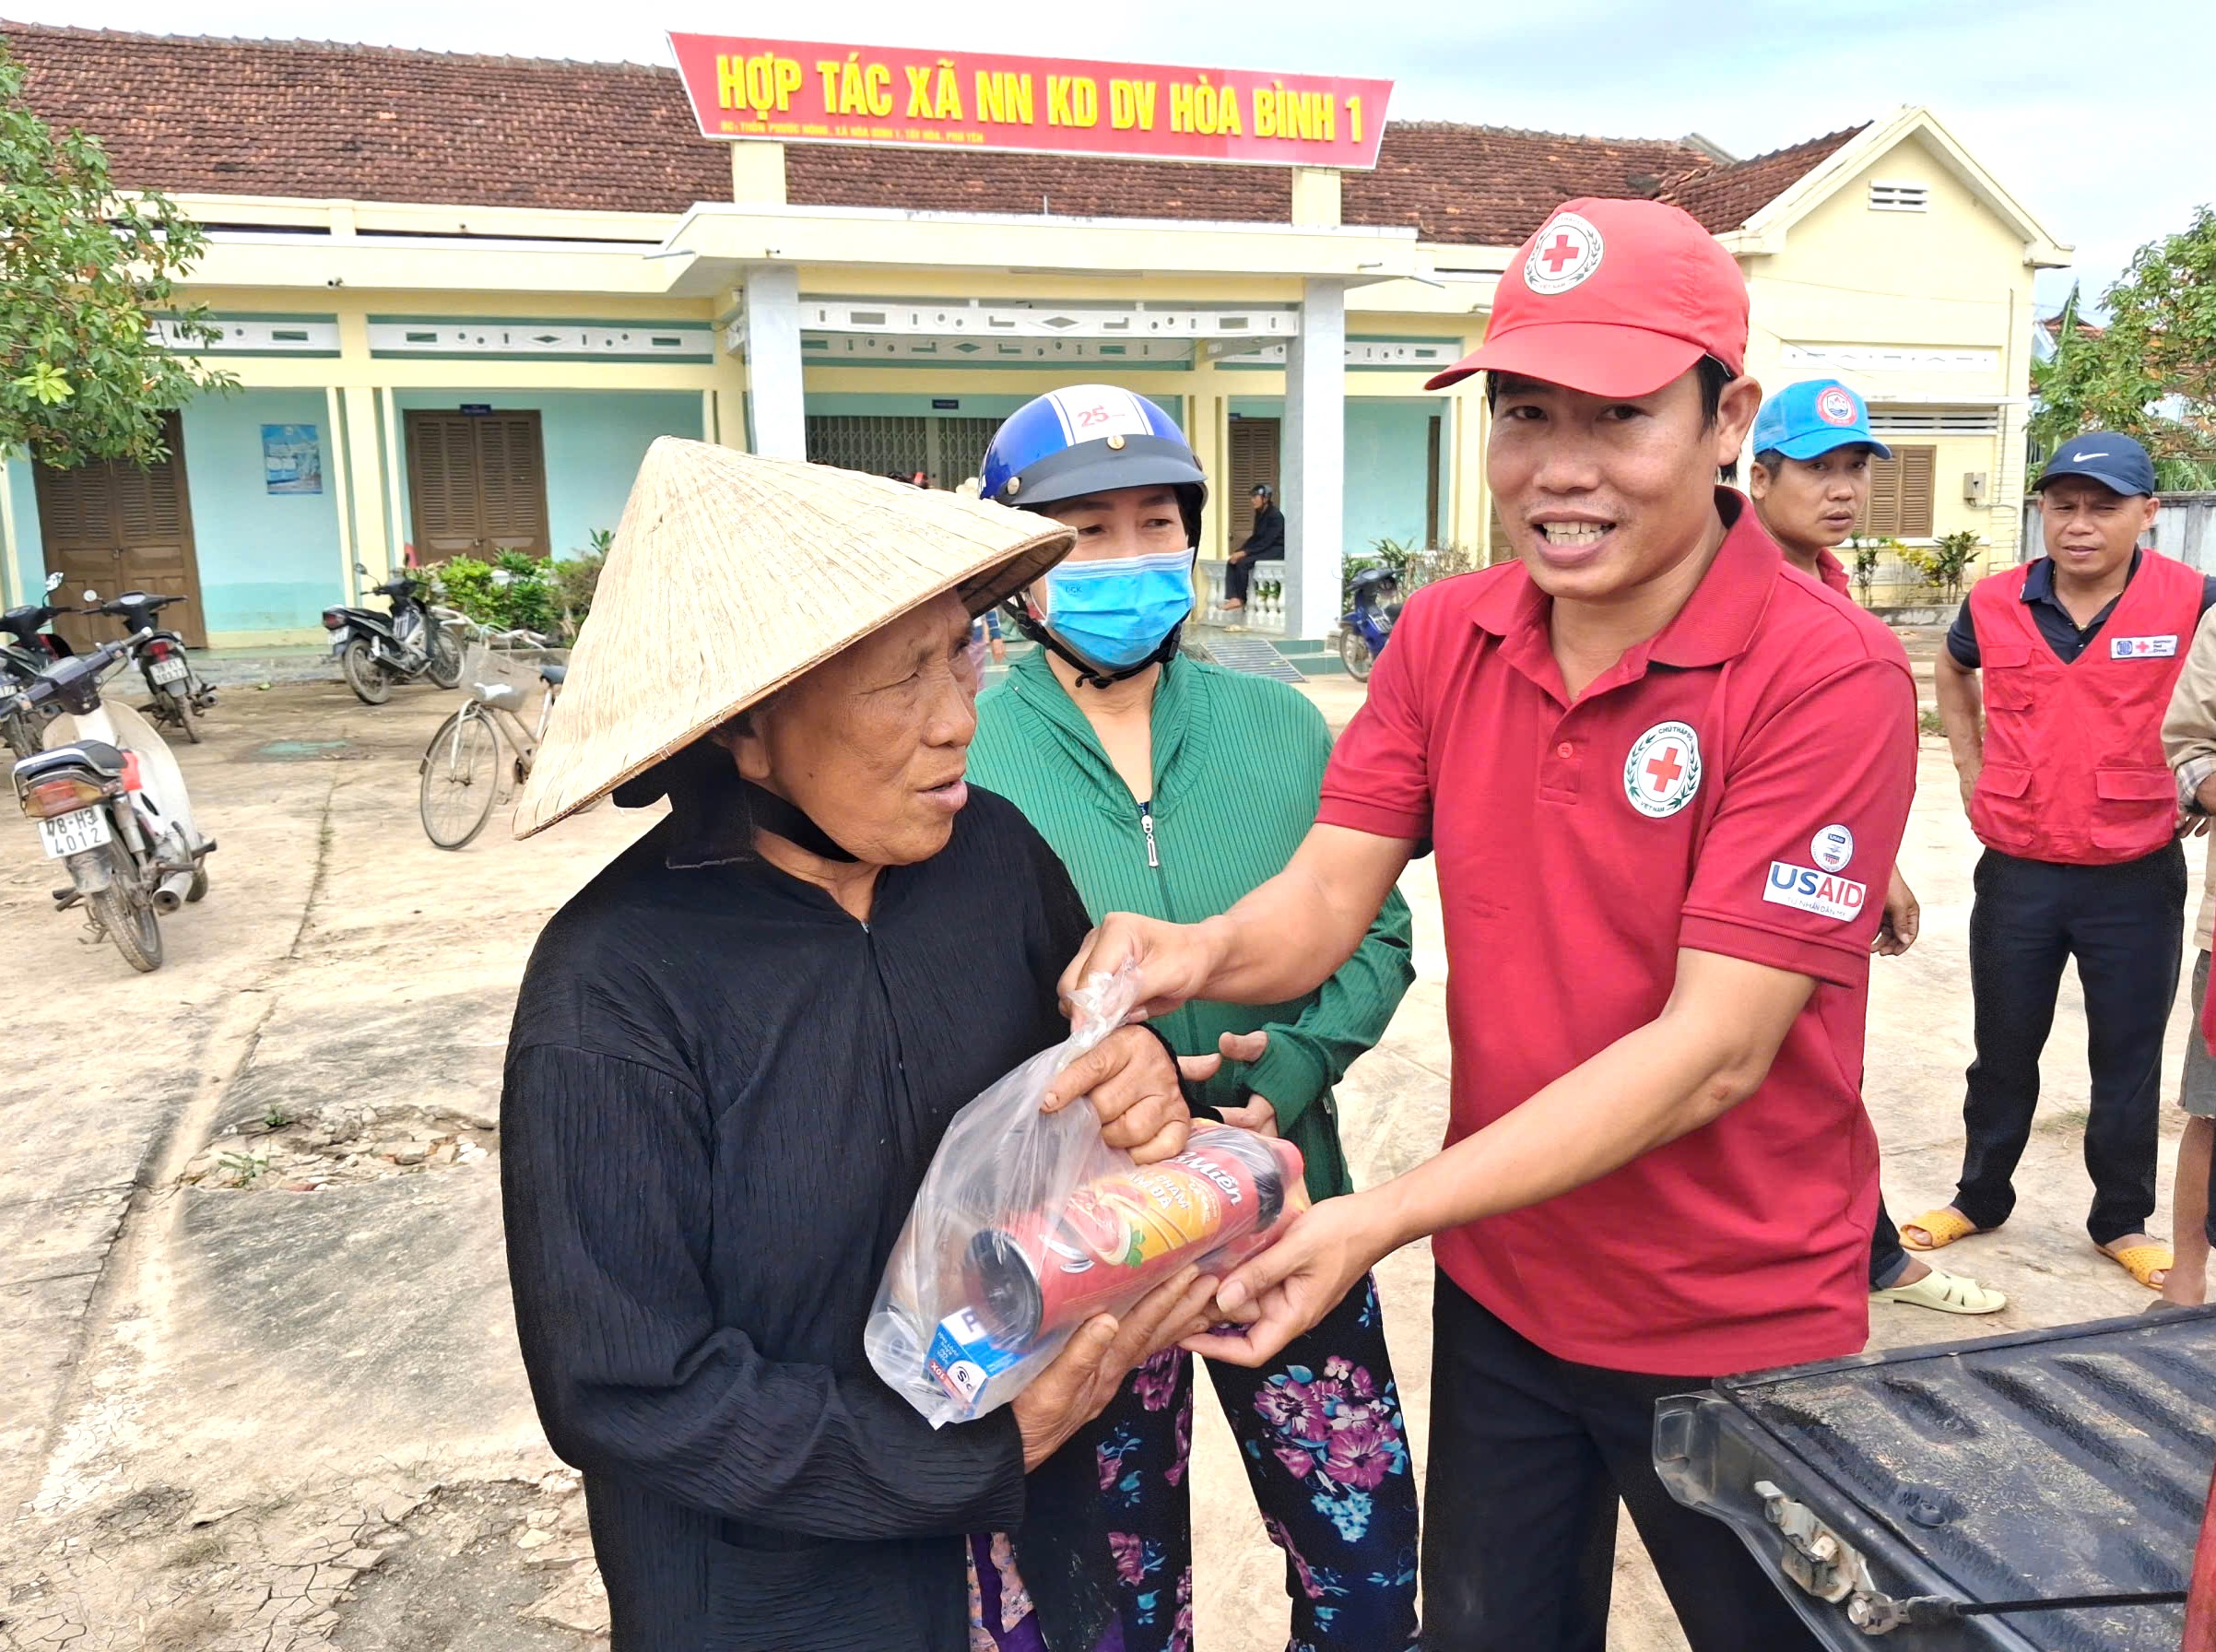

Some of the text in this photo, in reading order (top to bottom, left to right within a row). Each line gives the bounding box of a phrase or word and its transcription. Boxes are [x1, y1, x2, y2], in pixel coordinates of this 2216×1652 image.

[716, 51, 1362, 144] HỢP TÁC XÃ NN KD DV HÒA BÌNH 1
[1077, 405, 1110, 428] 25
[54, 828, 102, 855] 4012
[1771, 865, 1863, 908] USAID
